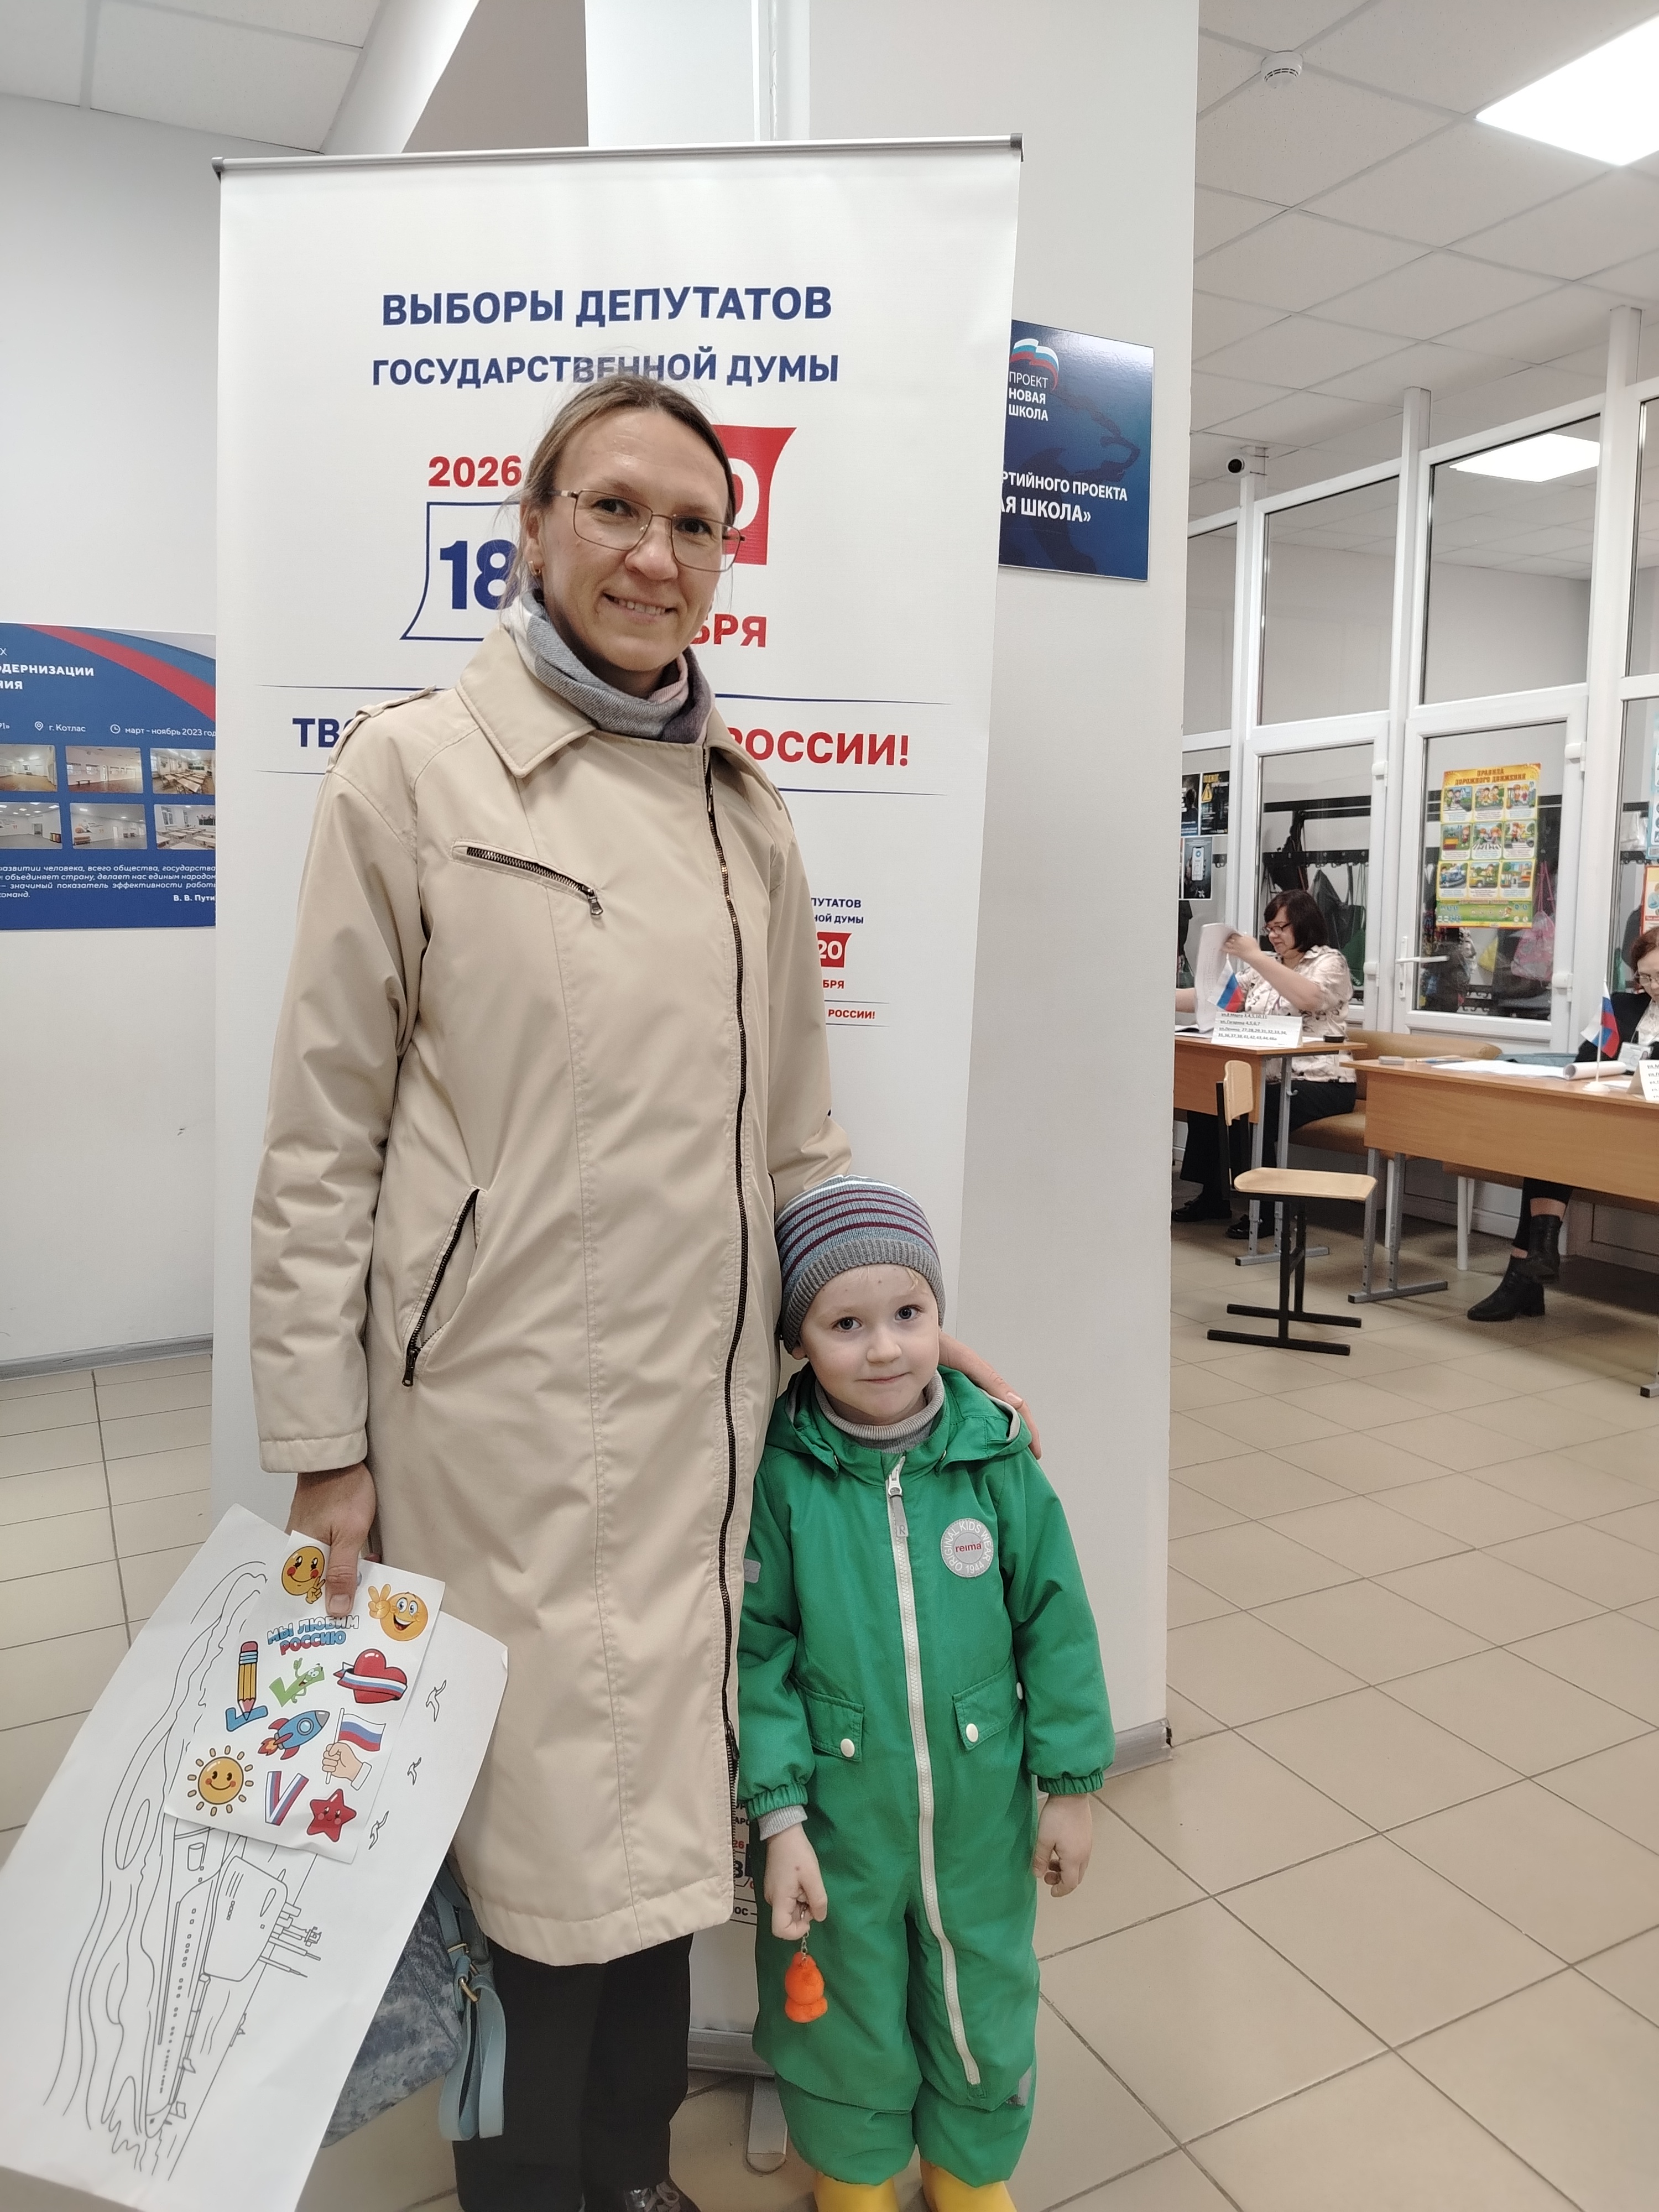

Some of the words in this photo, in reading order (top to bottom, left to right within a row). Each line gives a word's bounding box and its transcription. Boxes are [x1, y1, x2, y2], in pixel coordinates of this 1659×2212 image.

[383, 290, 563, 326] ВЫБОРЫ
[575, 286, 831, 327] ДЕПУТАТОВ
[726, 355, 838, 387] ДУМЫ
[1009, 371, 1048, 389] ПРОЕКТ
[1009, 387, 1046, 405] НОВАЯ
[1008, 404, 1048, 421] ШКОЛА
[429, 456, 522, 487] 2026
[1072, 481, 1128, 502] ПРОЕКТА
[1021, 498, 1092, 523] ШКОЛА»
[440, 539, 522, 610] 18
[152, 728, 181, 737] ноябрь
[293, 718, 354, 748] ТВ
[834, 915, 864, 924] ДУМЫ
[817, 940, 843, 960] 20
[828, 1009, 875, 1020] РОССИИ!
[943, 1528, 963, 1571] ORIGINAL
[959, 1521, 982, 1534] KIDS
[980, 1530, 992, 1562] WEAR
[955, 1543, 982, 1552] reima
[966, 1561, 985, 1574] 1944
[267, 1623, 294, 1645] МЫ
[298, 1615, 359, 1635] ЛЮБИМ
[280, 1630, 346, 1656] РОССИЮ
